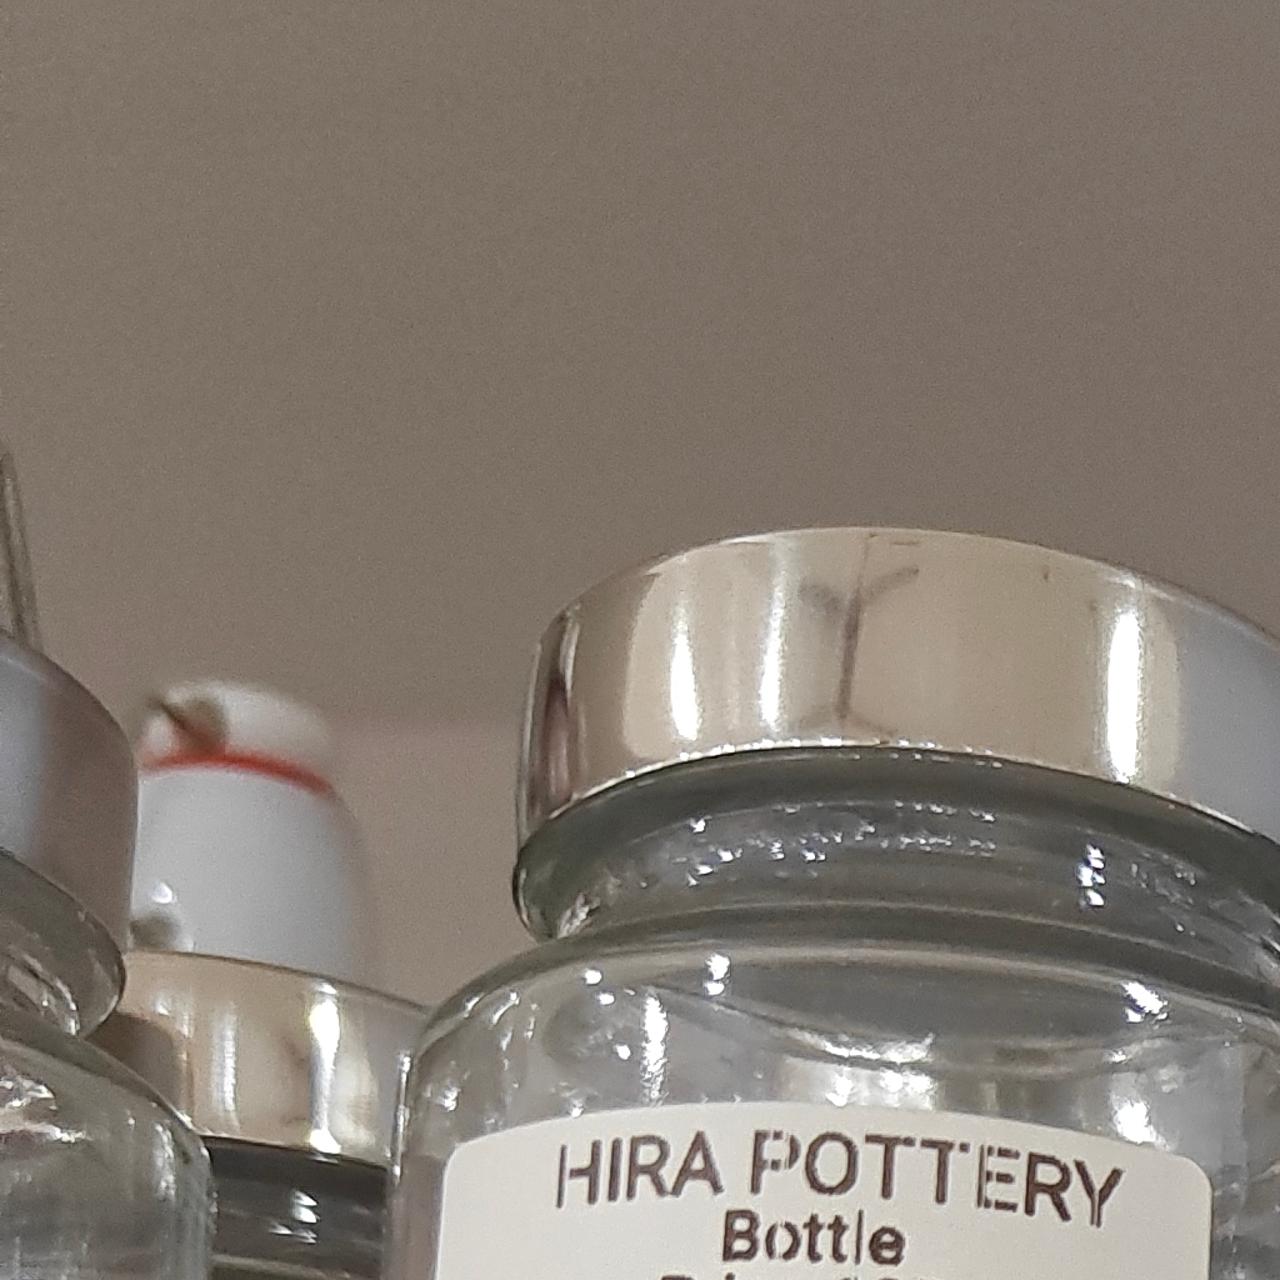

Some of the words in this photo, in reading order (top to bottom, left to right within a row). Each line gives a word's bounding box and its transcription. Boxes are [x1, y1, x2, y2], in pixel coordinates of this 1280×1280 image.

[555, 1130, 724, 1208] HIRA
[751, 1129, 1125, 1228] POTTERY
[721, 1208, 906, 1267] Bottle
